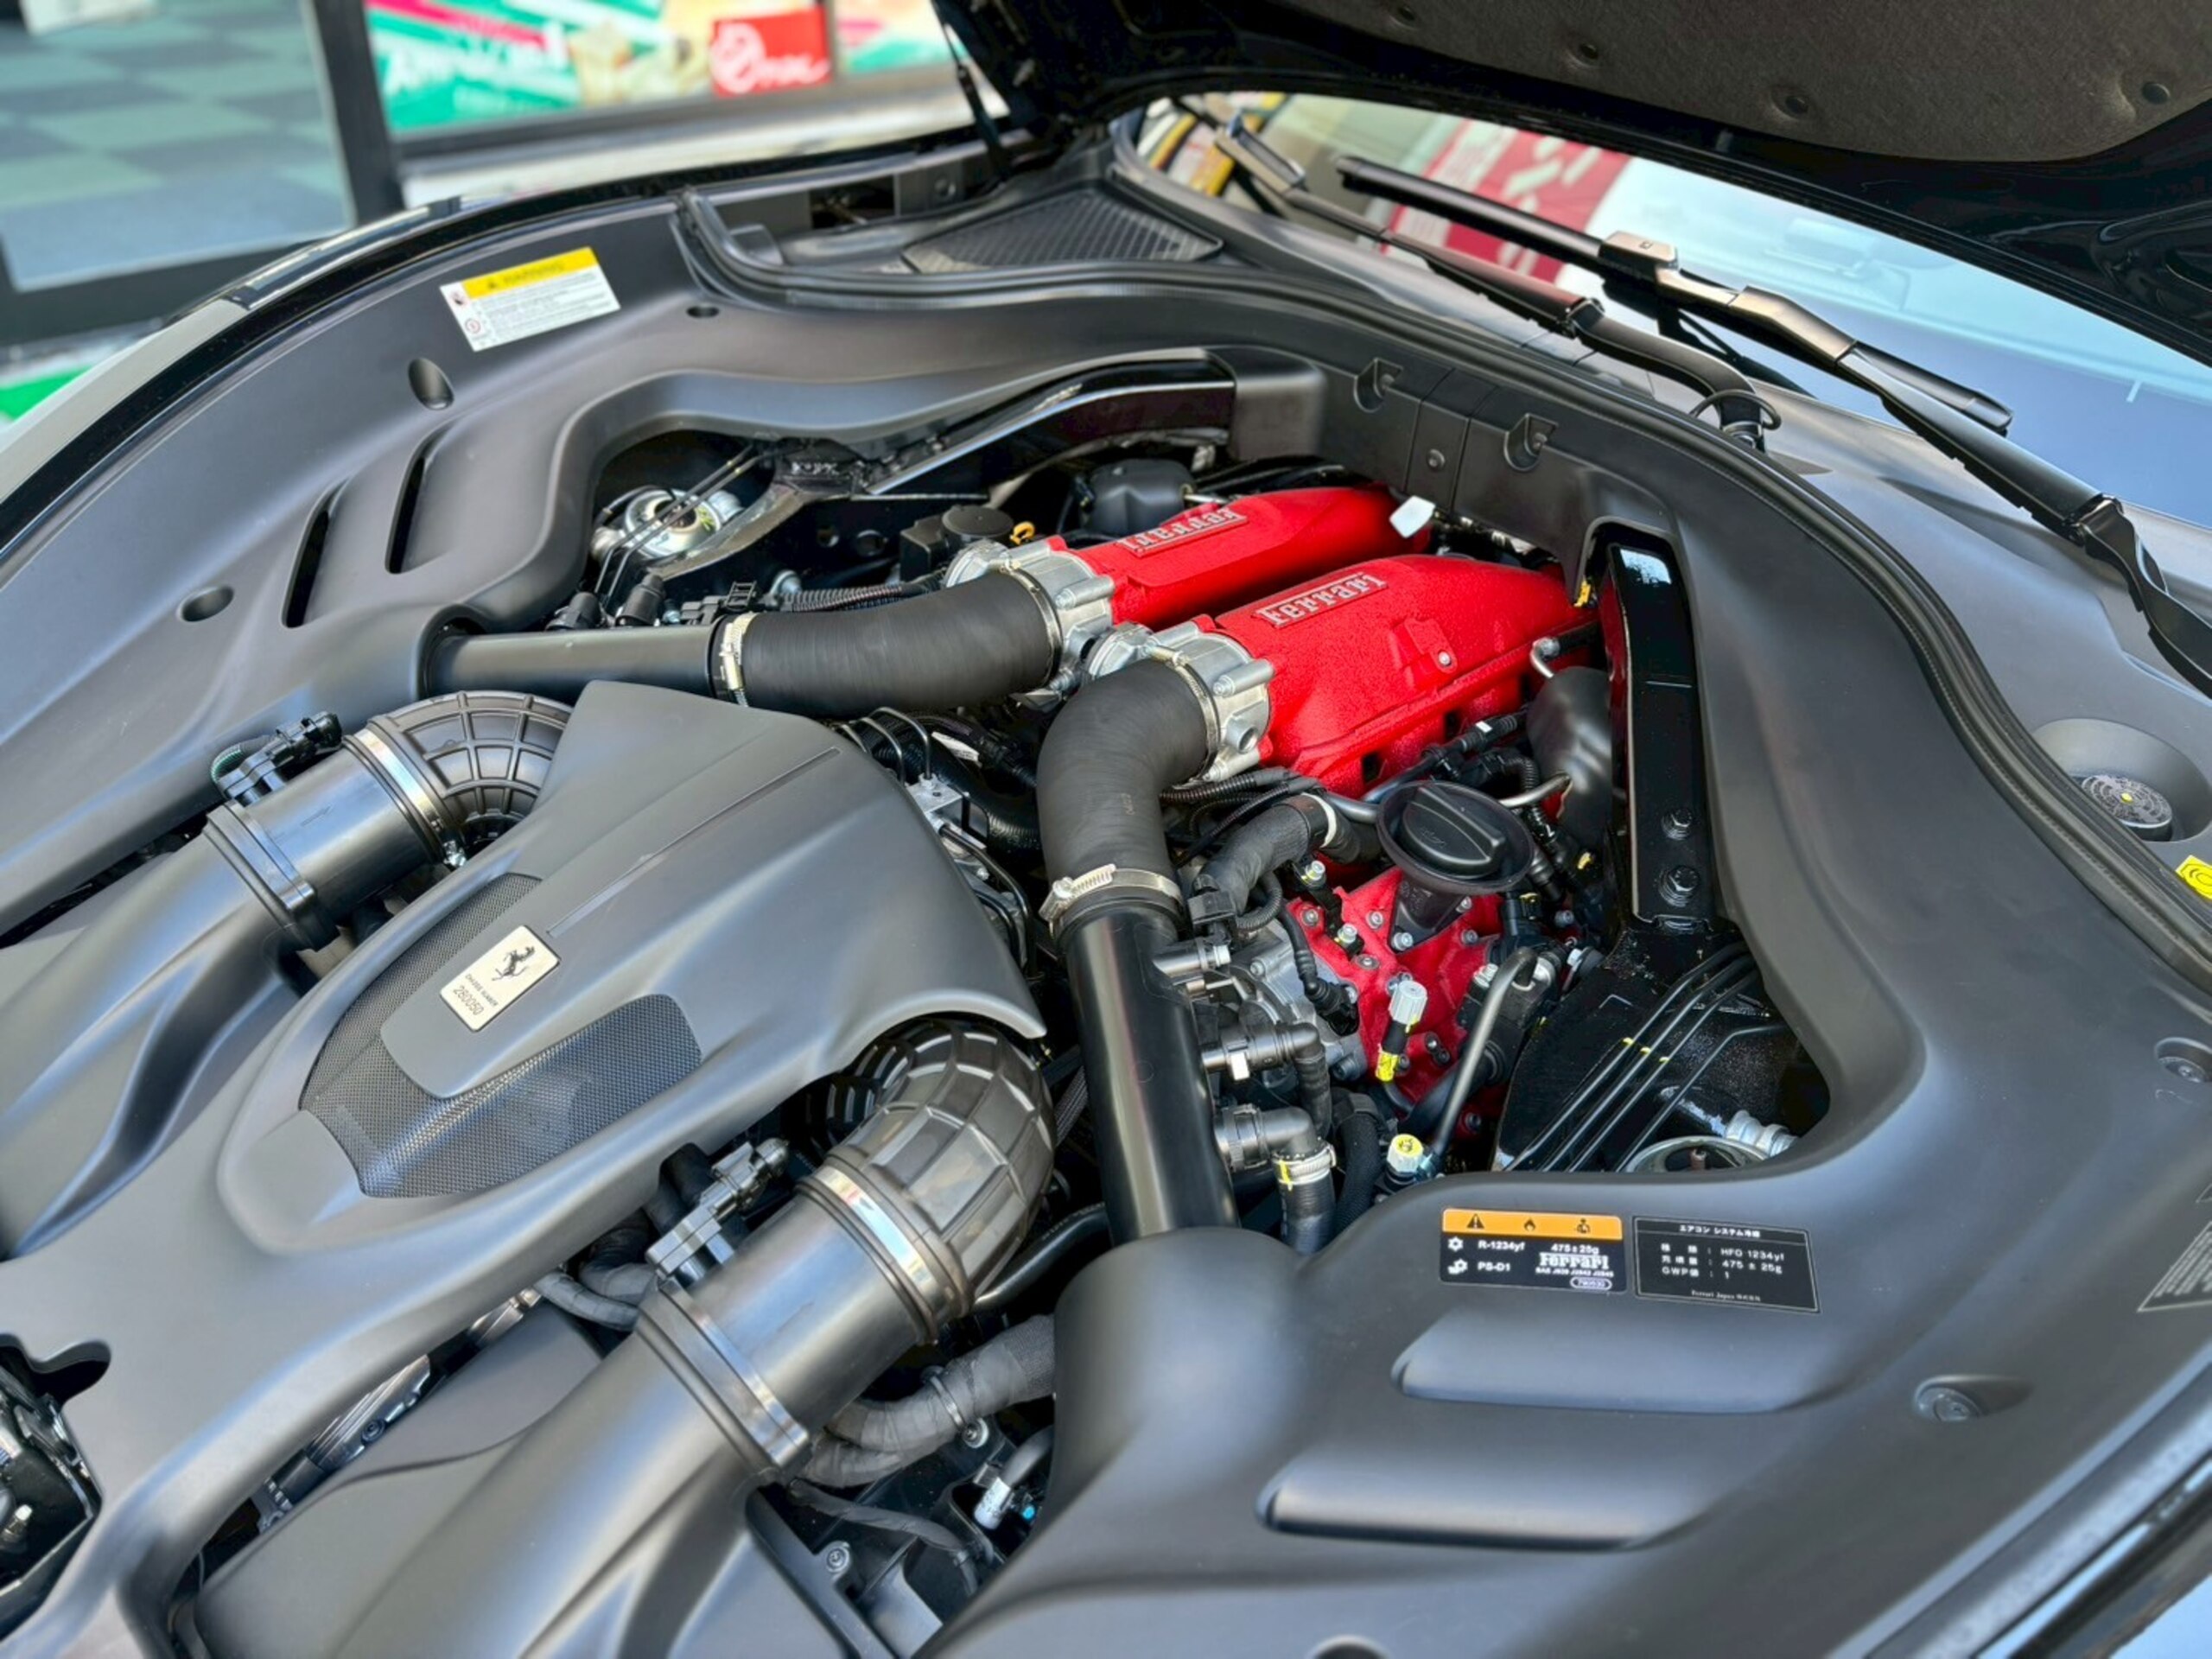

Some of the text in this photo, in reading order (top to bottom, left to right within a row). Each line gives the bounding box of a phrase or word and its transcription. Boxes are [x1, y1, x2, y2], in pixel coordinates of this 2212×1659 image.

[1255, 571, 1388, 626] Ferrari
[1478, 1239, 1525, 1252] R-1234yf
[1539, 1252, 1609, 1270] Ferrari
